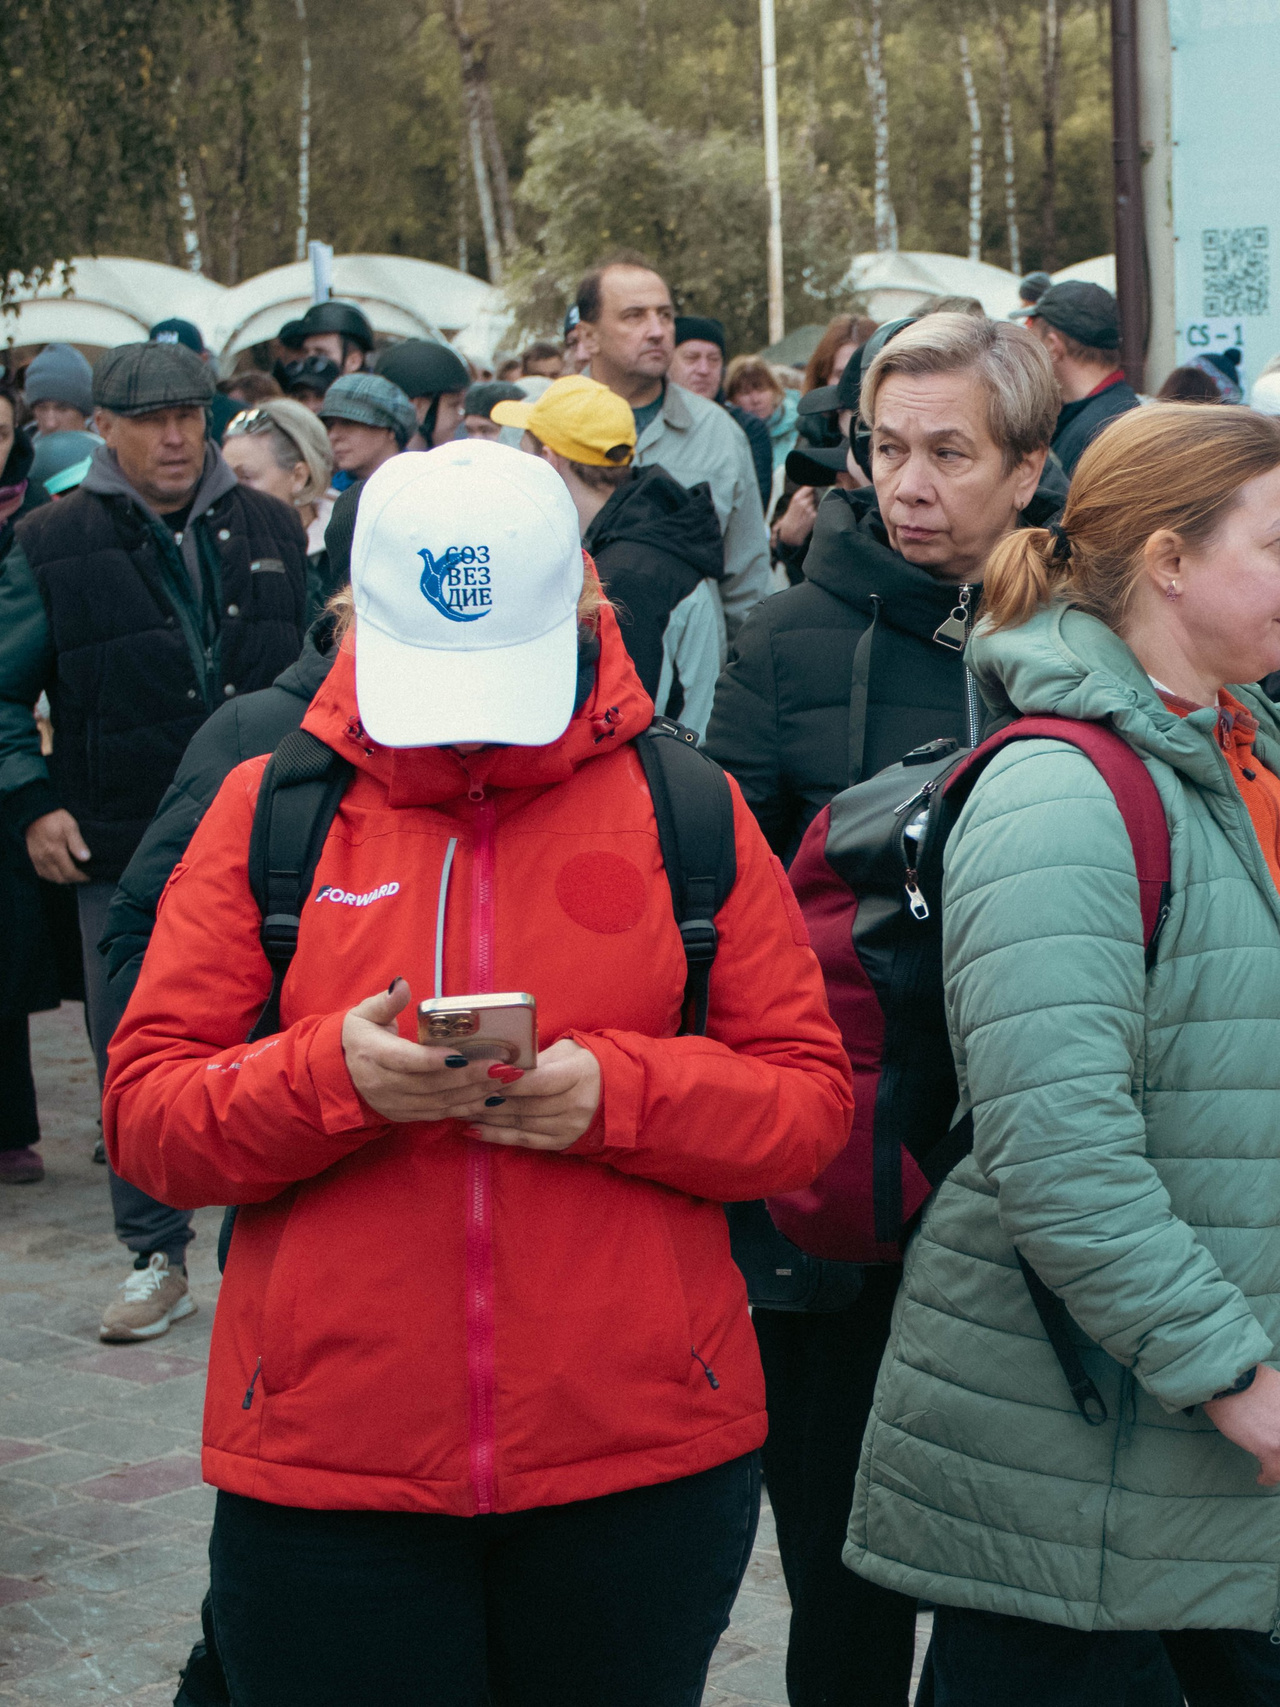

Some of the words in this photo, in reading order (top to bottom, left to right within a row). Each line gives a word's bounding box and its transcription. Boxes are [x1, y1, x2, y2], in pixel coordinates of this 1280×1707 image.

[446, 545, 490, 565] СОЗ
[446, 566, 491, 587] ВЕЗ
[446, 587, 493, 611] ДИЕ
[315, 881, 400, 907] FORWARD
